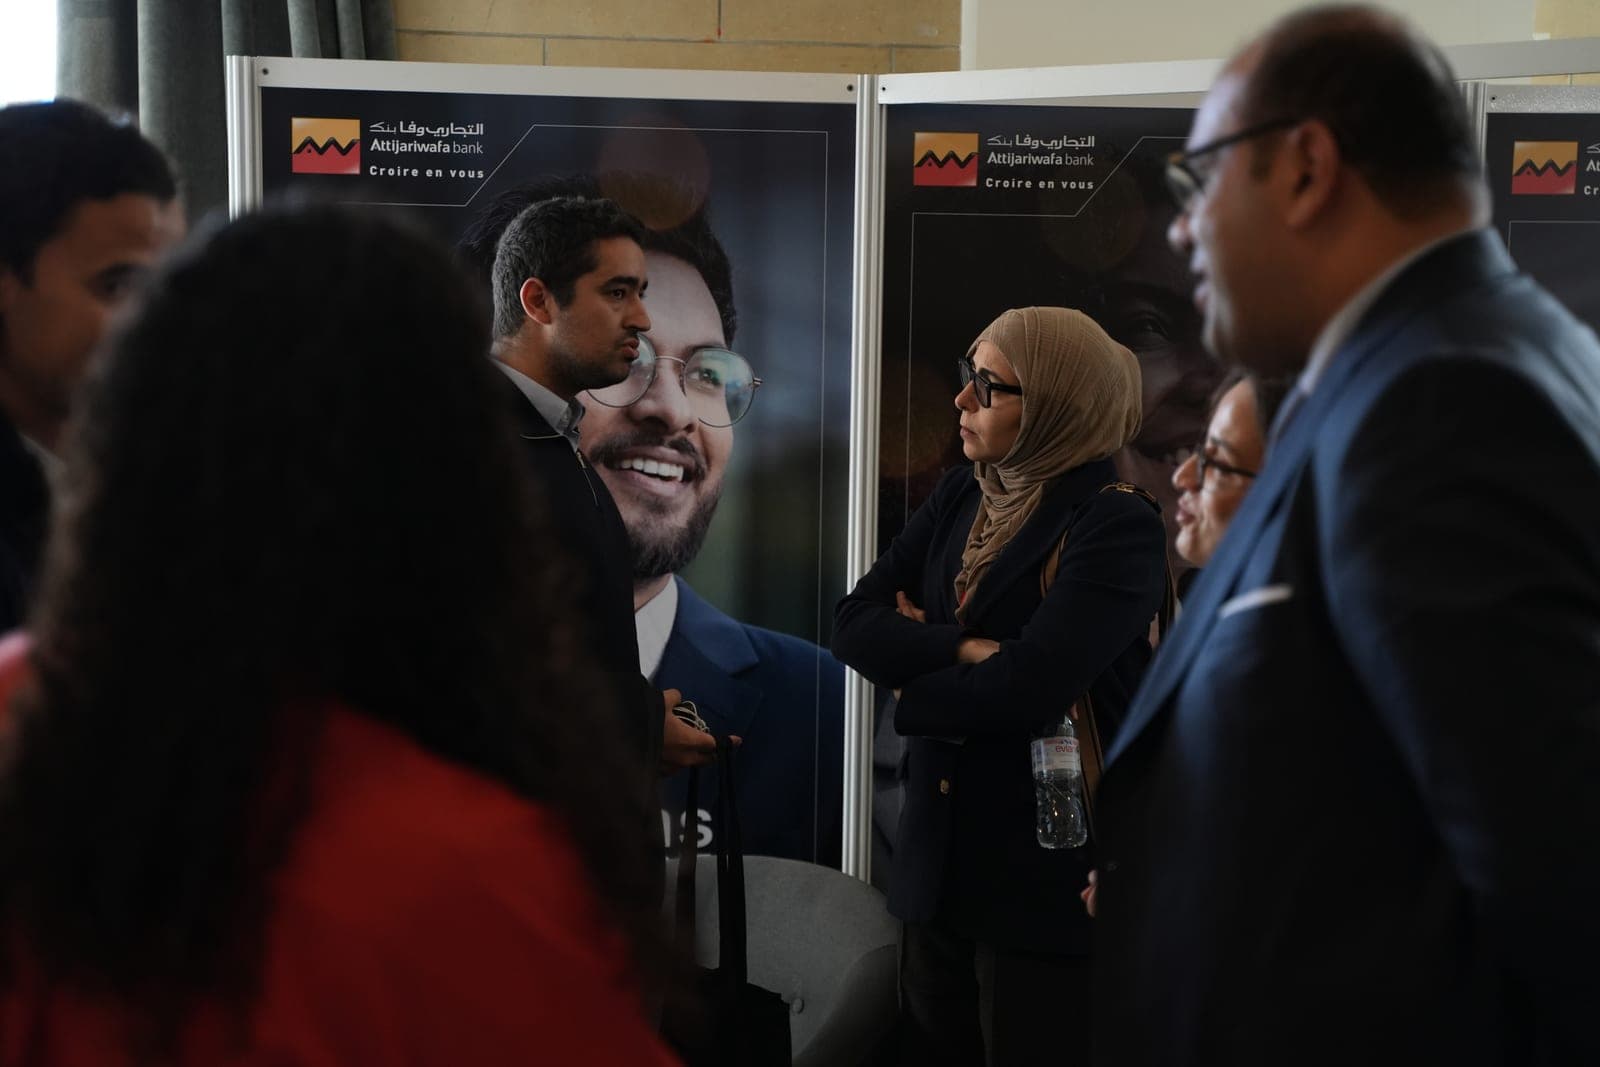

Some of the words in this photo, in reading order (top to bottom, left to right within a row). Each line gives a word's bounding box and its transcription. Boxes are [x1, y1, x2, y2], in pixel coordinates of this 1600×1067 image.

[369, 138, 451, 155] Attijariwafa
[452, 140, 484, 154] bank
[986, 151, 1063, 167] Attijariwafa
[1064, 152, 1095, 166] bank
[369, 165, 419, 177] Croire
[425, 168, 443, 178] en
[449, 169, 484, 179] vous
[985, 177, 1033, 189] Croire
[1038, 180, 1055, 190] en
[1060, 180, 1095, 190] vous
[1055, 744, 1078, 753] evia
